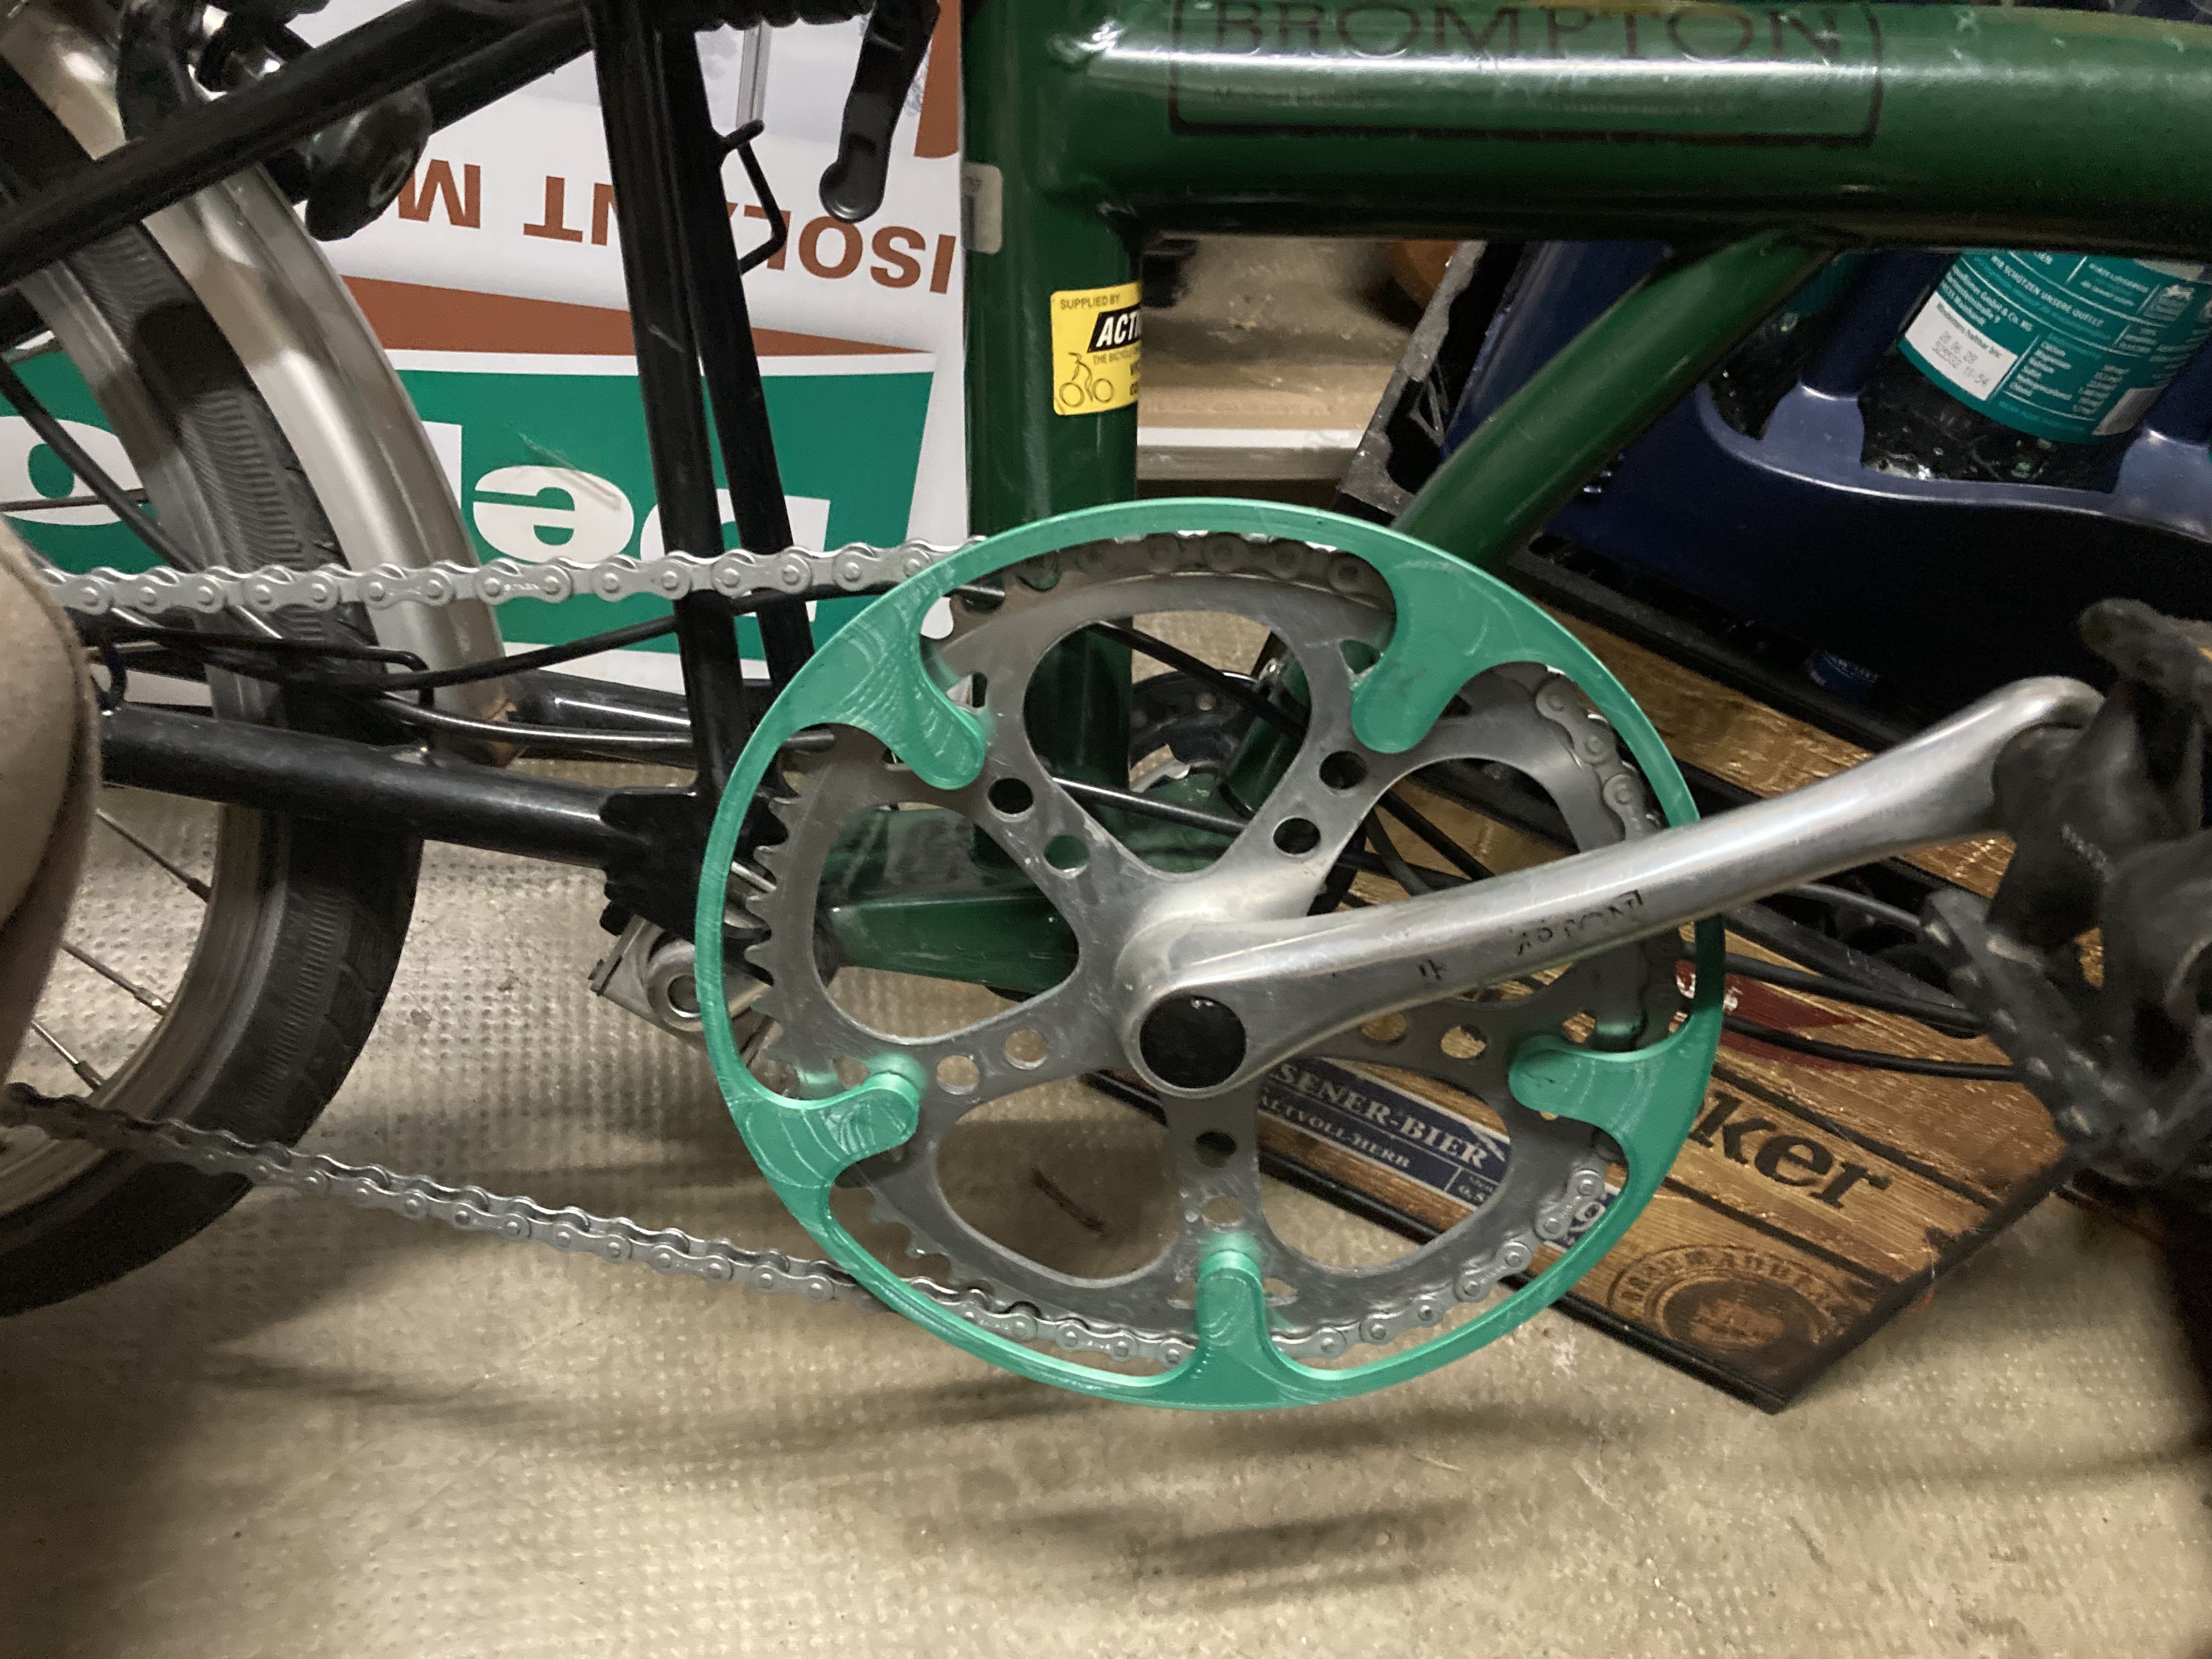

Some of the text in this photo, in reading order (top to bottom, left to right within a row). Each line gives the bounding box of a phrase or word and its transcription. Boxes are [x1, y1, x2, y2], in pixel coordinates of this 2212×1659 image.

[1216, 2, 1842, 64] BROMPTON
[1274, 1062, 1488, 1169] SENER-BIER
[1689, 1090, 1892, 1209] ker
